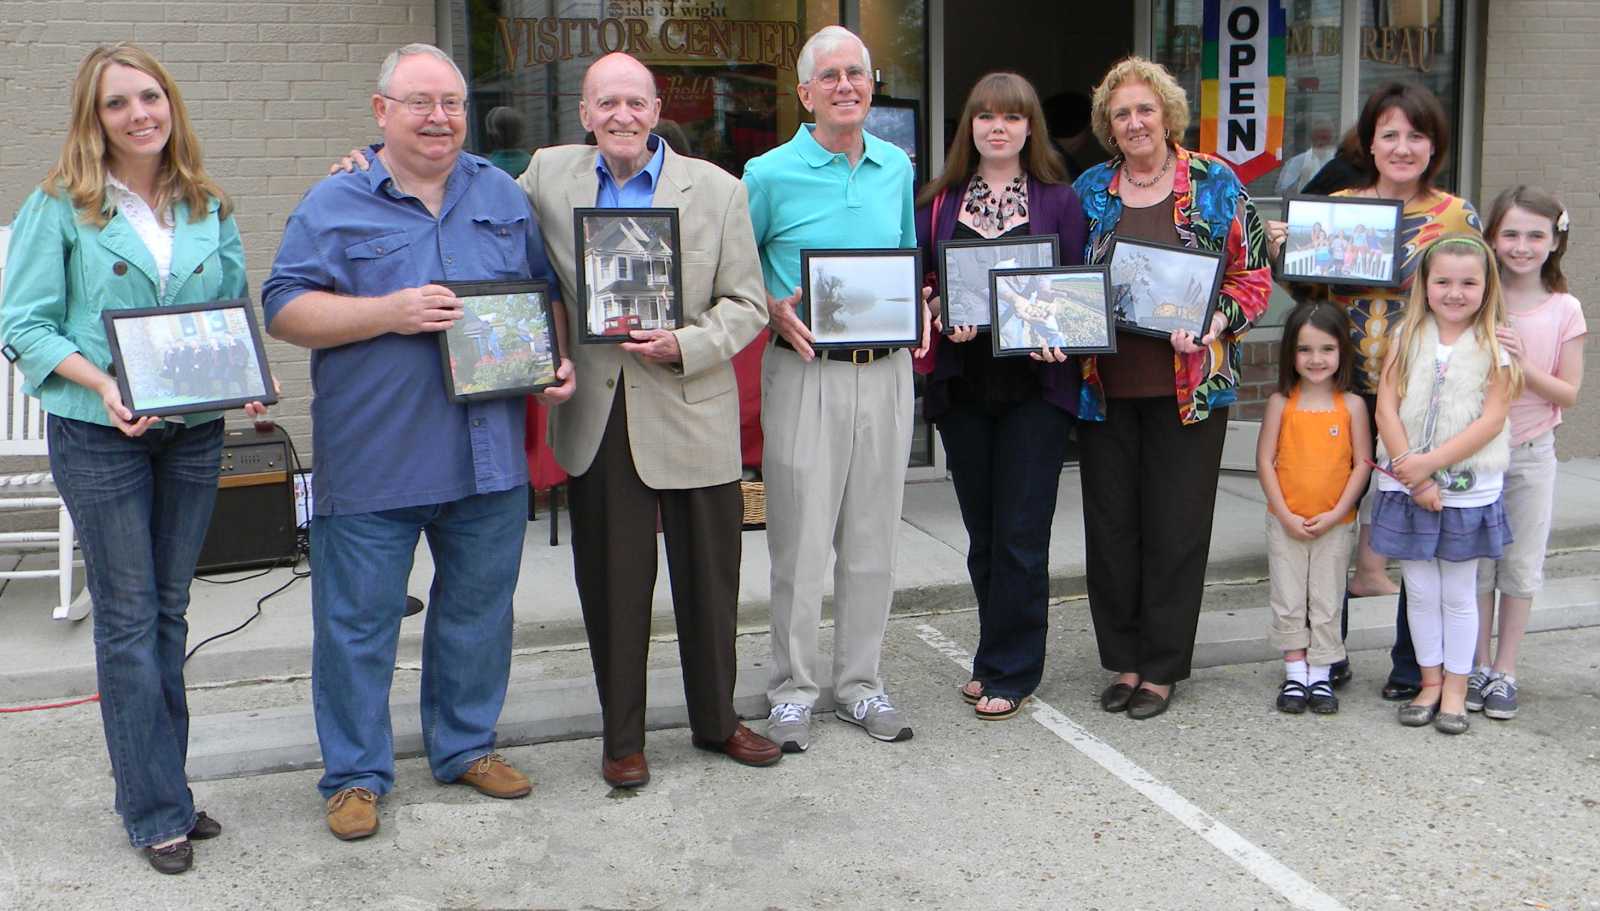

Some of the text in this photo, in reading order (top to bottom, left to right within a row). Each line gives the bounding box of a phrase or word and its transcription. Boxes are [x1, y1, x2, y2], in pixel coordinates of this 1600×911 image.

[627, 0, 654, 16] isle
[659, 0, 675, 16] of
[681, 2, 727, 21] wight
[497, 16, 802, 73] VISITOR CENTER
[1322, 26, 1437, 72] BREAU
[1227, 6, 1259, 152] OPEN
